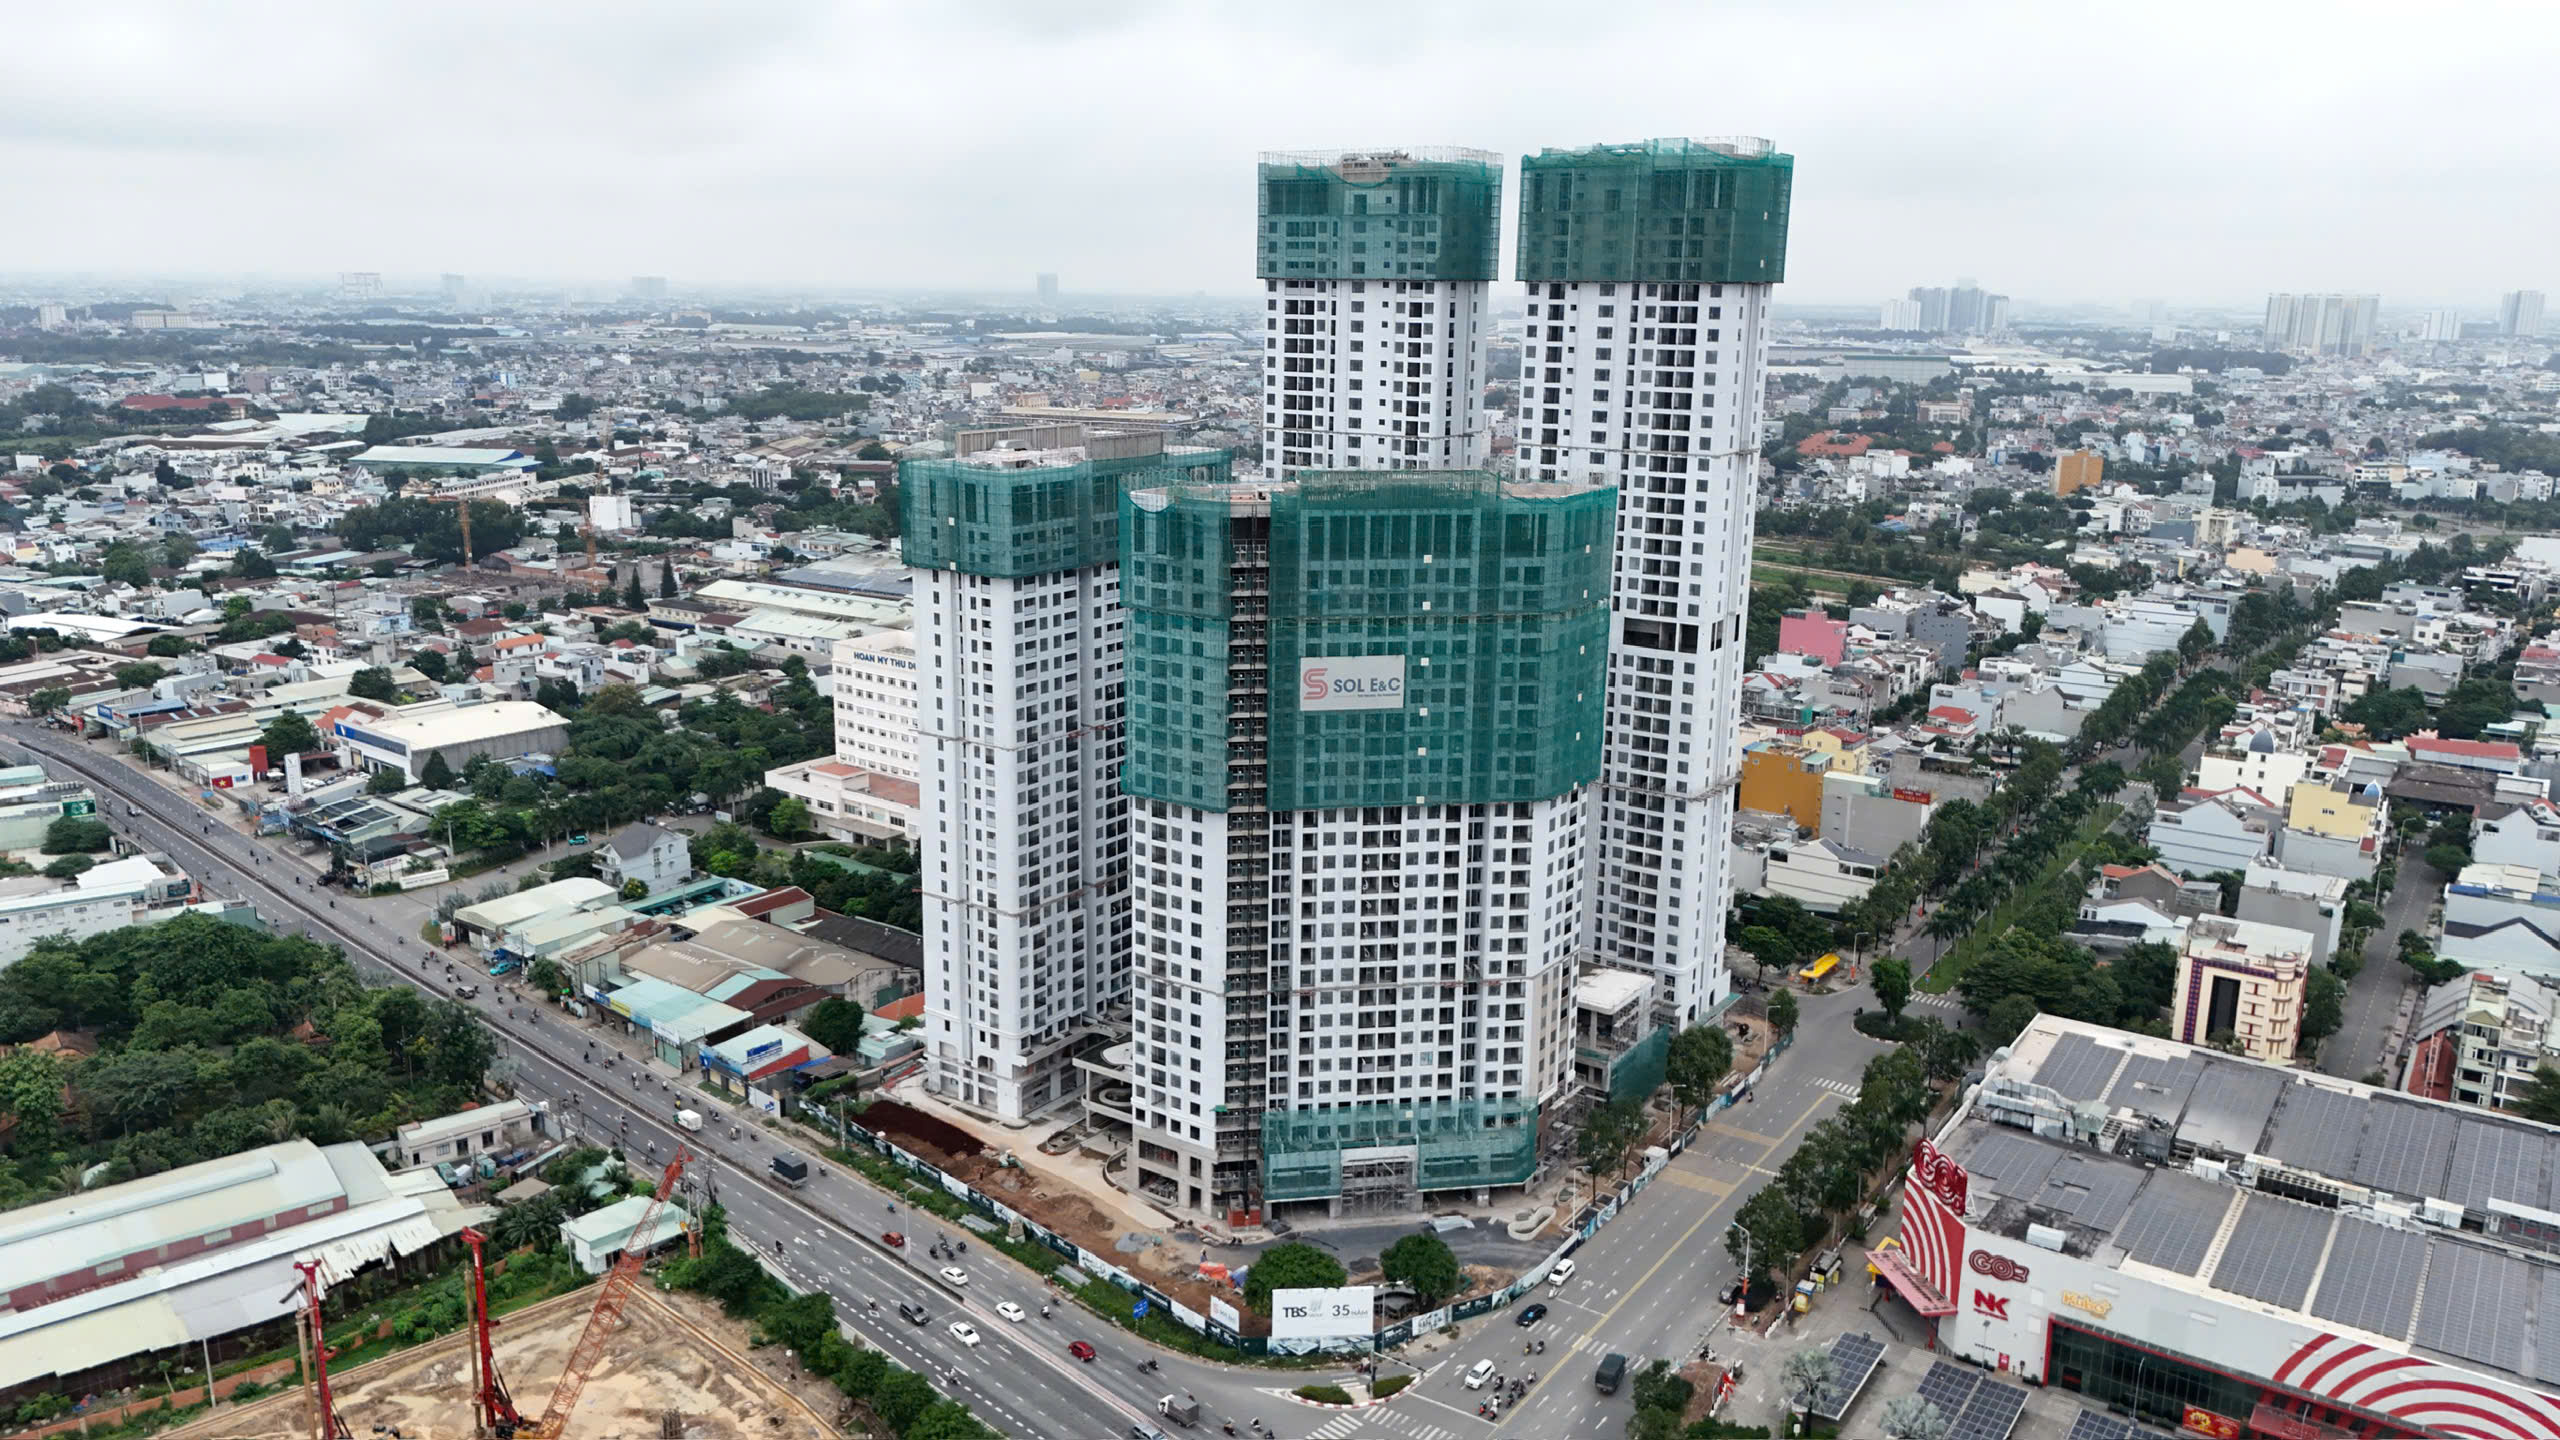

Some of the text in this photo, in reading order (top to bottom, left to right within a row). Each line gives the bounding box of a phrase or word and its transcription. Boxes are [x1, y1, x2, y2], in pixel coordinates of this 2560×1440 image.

[890, 658, 906, 668] THU
[1333, 677, 1401, 693] SOL E&C
[1968, 1249, 2030, 1284] GO!
[1974, 1287, 2011, 1318] NK
[1283, 1306, 1307, 1318] TBS
[1332, 1304, 1350, 1317] 35
